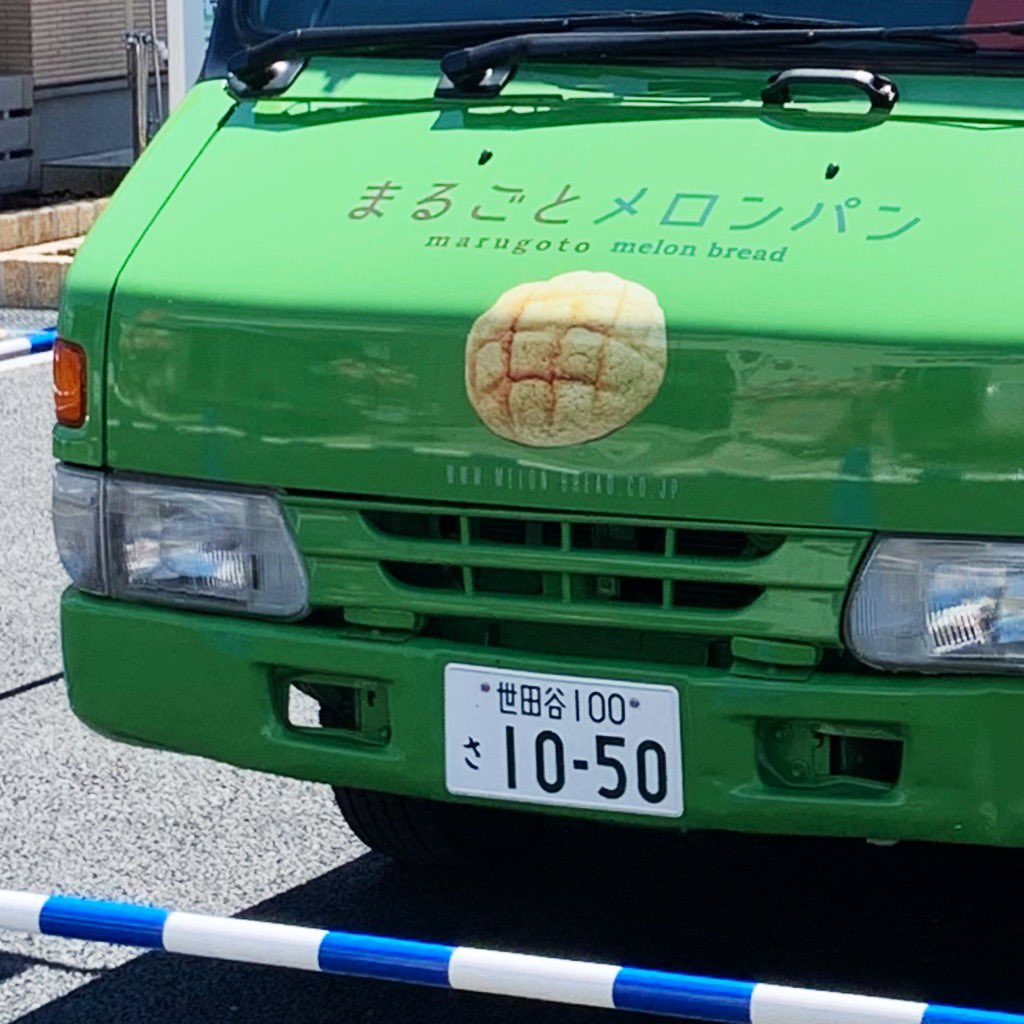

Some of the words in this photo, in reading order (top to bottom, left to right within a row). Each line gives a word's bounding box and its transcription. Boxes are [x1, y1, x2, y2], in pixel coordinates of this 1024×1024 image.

[347, 179, 921, 241] まるごとメロンパン
[425, 234, 591, 255] marugoto
[610, 237, 697, 257] melon
[707, 241, 788, 263] bread
[497, 682, 566, 720] 世田谷
[574, 689, 626, 725] 100
[463, 736, 481, 770] さ
[505, 725, 668, 804] 10-50
